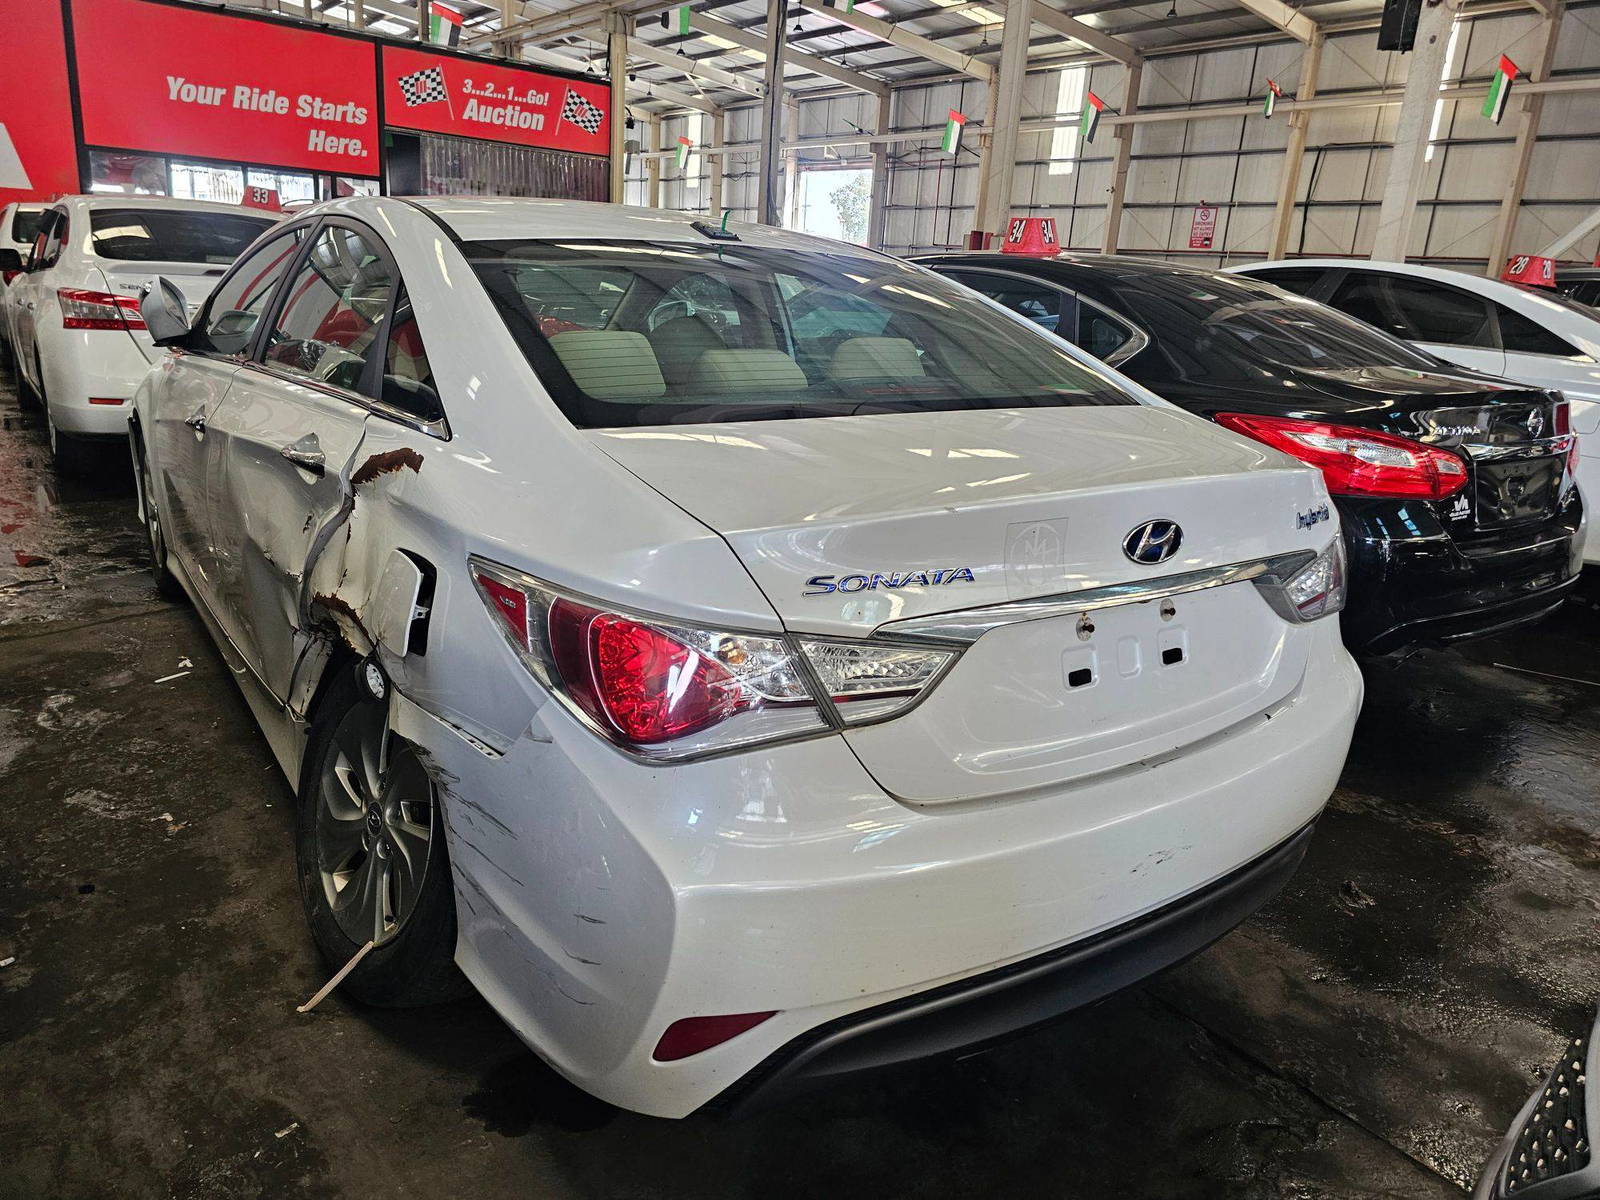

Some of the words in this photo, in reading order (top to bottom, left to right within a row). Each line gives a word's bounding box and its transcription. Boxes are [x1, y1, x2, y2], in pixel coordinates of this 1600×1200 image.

[166, 75, 227, 107] Your
[232, 85, 290, 115] Ride
[296, 94, 369, 126] Starts
[462, 98, 546, 132] Auction
[307, 129, 369, 158] Here.
[253, 187, 269, 204] 33
[1009, 219, 1027, 244] 34
[1041, 219, 1055, 244] 34
[802, 567, 976, 598] SONATA
